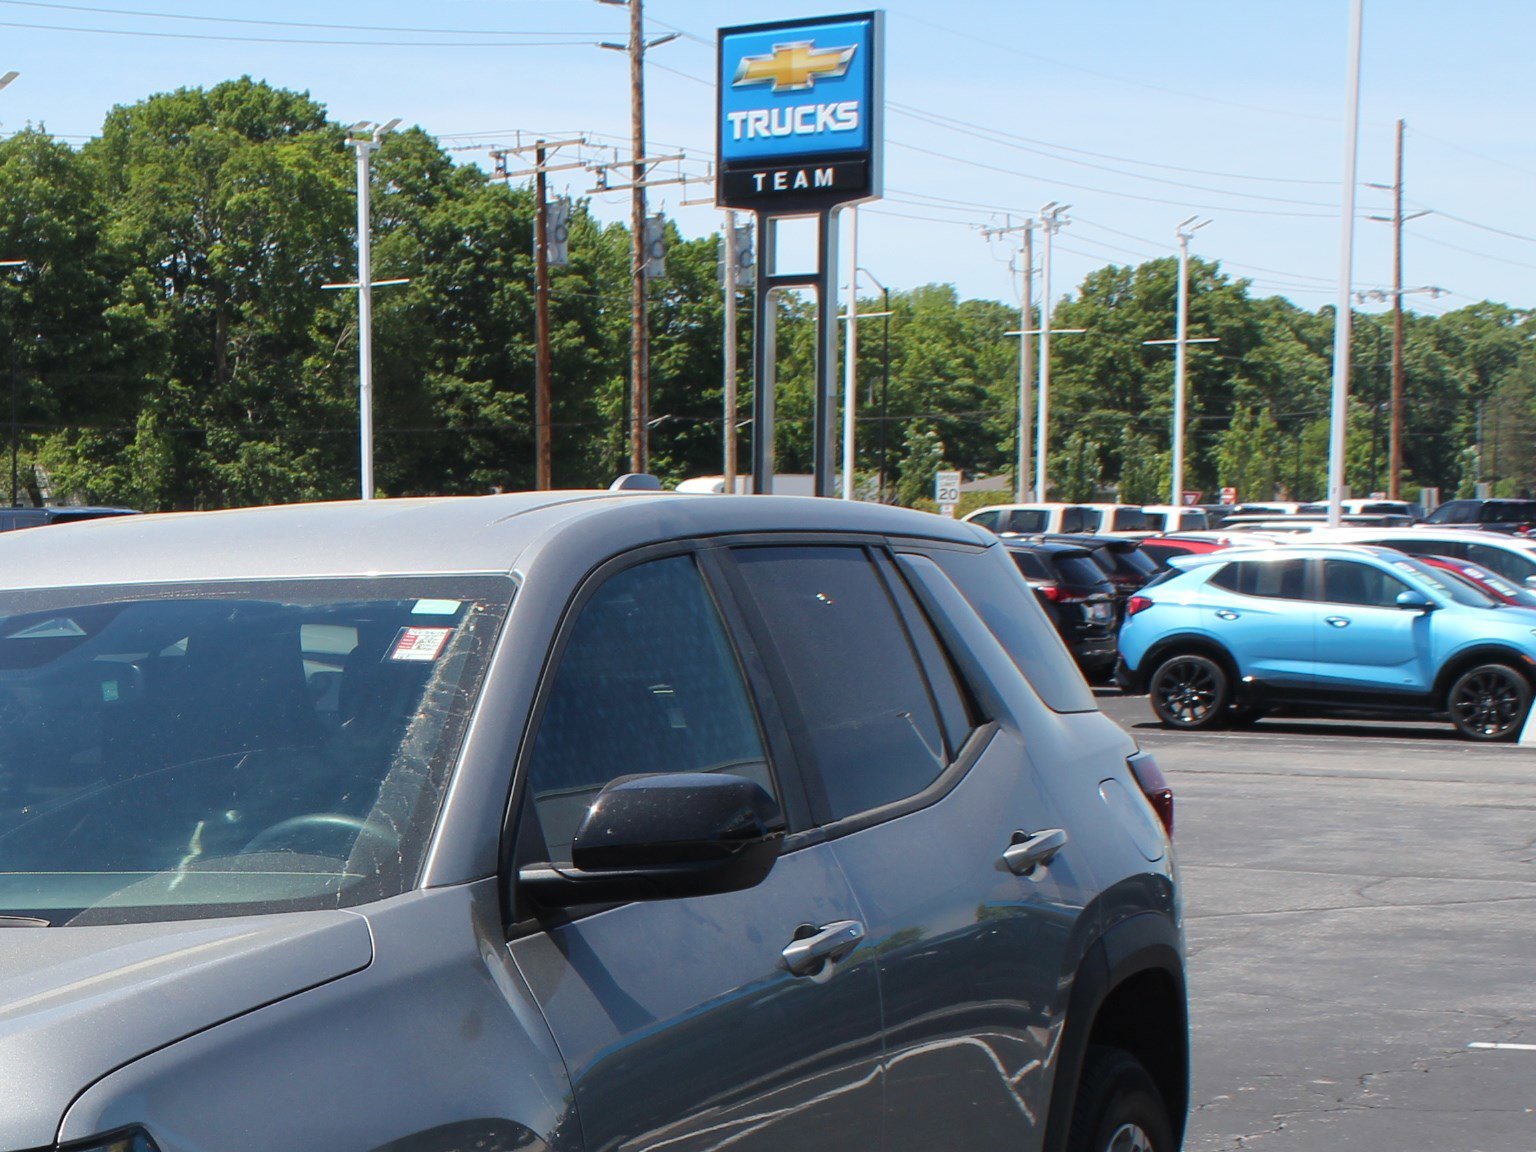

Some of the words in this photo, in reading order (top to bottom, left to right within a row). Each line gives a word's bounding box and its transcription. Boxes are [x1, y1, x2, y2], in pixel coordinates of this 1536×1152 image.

[726, 101, 859, 141] TRUCKS
[752, 167, 834, 192] TEAM
[939, 488, 958, 500] 20
